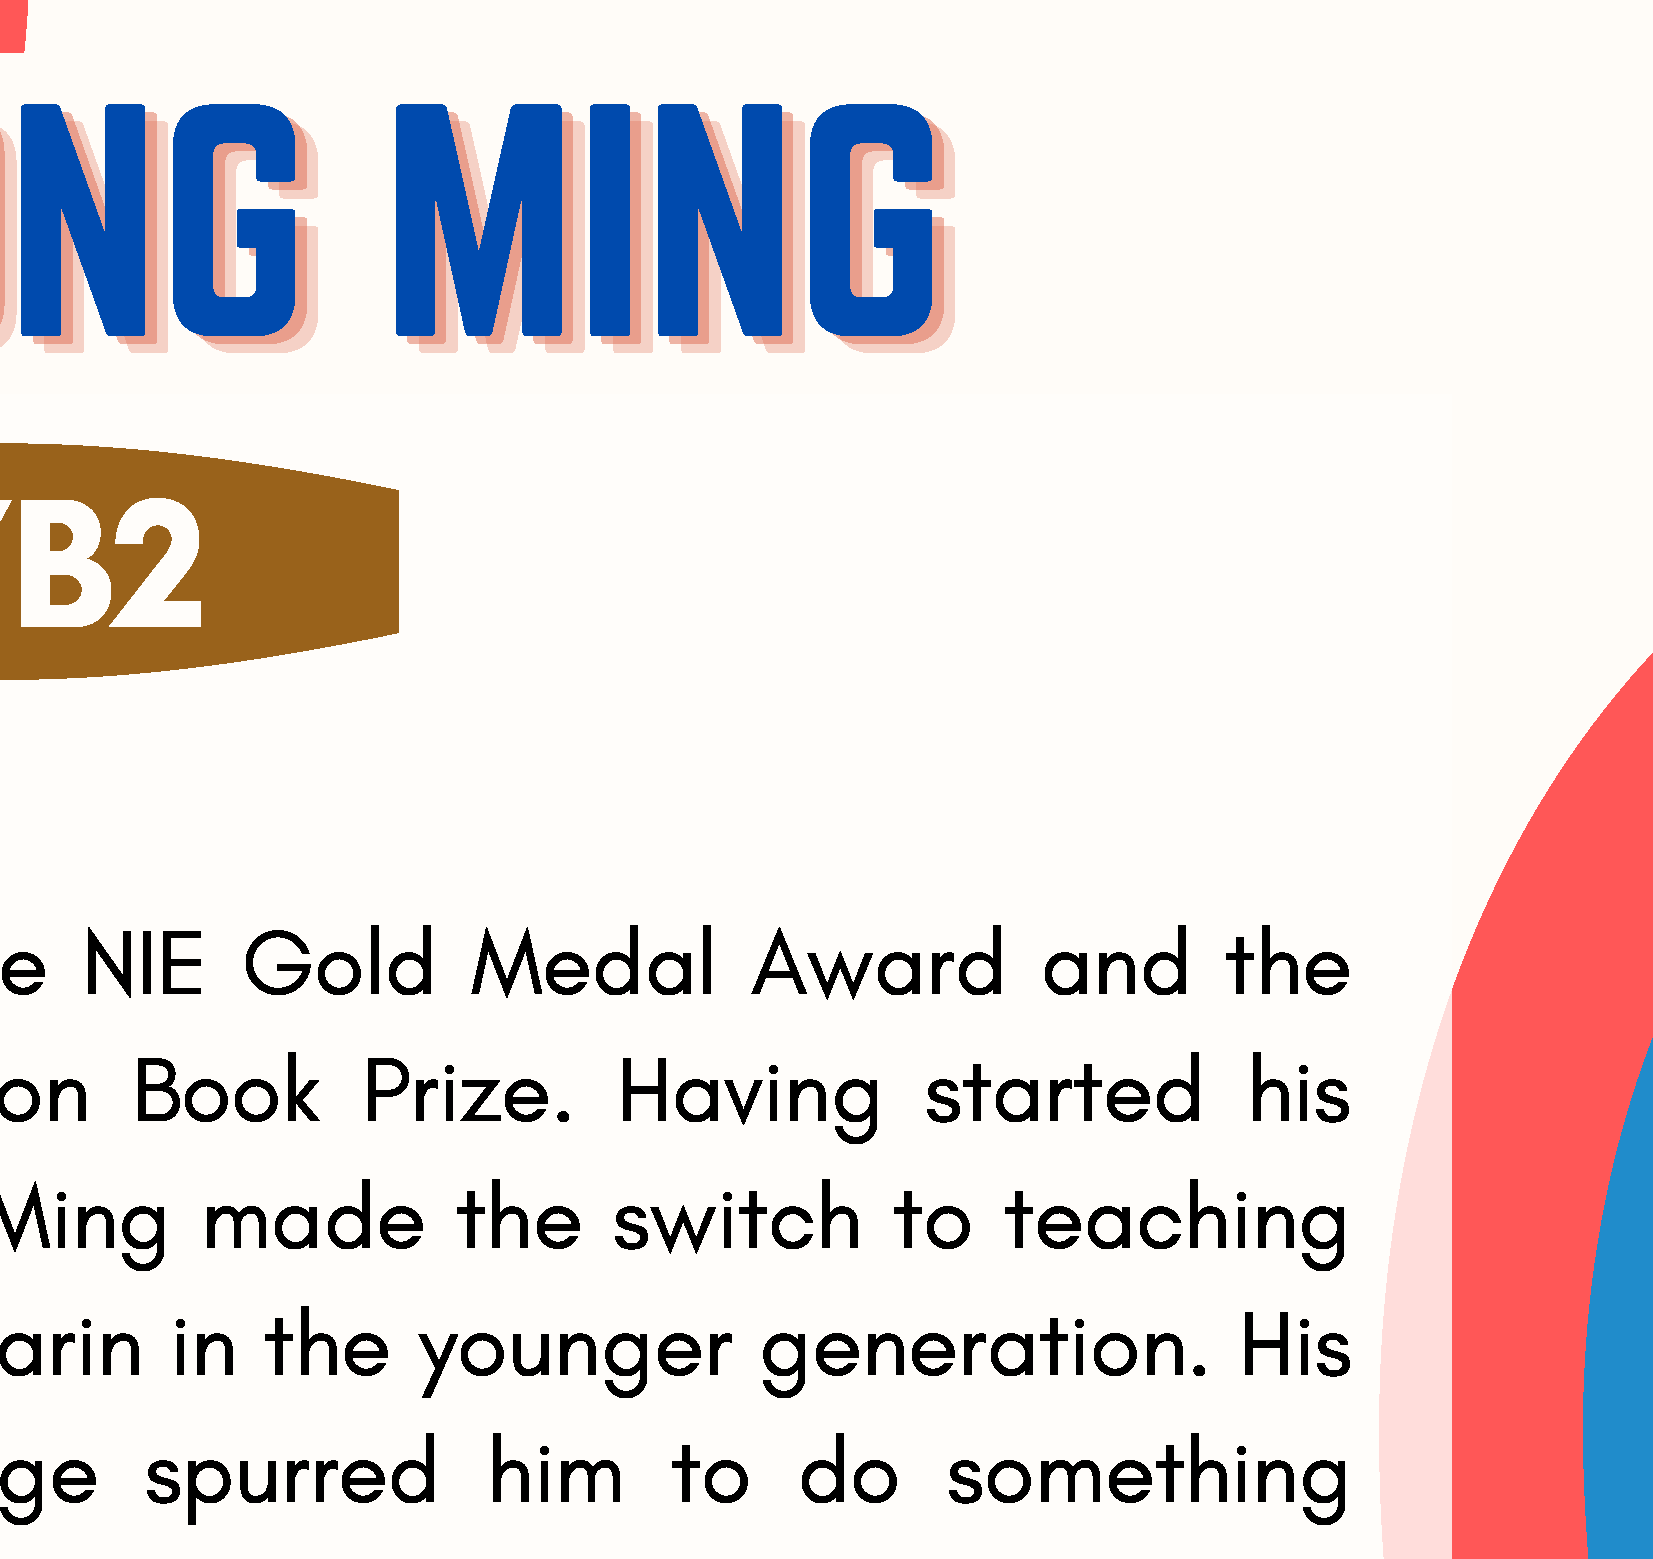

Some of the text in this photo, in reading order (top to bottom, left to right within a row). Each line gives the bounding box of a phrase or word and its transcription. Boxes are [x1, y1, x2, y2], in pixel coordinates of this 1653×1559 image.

[396, 104, 932, 336] MING
[88, 927, 201, 998] NIE
[246, 925, 431, 995] Gold
[471, 925, 711, 998] Medal
[751, 925, 1001, 1000] Award
[1045, 925, 1186, 995] and
[1226, 925, 1349, 995] the
[138, 1052, 320, 1122] Book
[368, 1058, 569, 1122] Prize.
[623, 1058, 877, 1144] Having
[927, 1052, 1199, 1123] started
[1253, 1052, 1349, 1123] his
[207, 1179, 423, 1249] made
[457, 1179, 580, 1249] the
[615, 1179, 858, 1254] switch
[894, 1191, 970, 1249] to
[1005, 1179, 1344, 1271] teaching
[176, 1319, 233, 1375] in
[265, 1306, 388, 1376] the
[418, 1333, 732, 1398] younger
[763, 1318, 1205, 1398] generation.
[1245, 1312, 1350, 1377] His
[147, 1433, 434, 1525] spurred
[493, 1433, 620, 1502] him
[672, 1445, 748, 1503] to
[802, 1433, 897, 1503] do
[949, 1433, 1345, 1525] something
